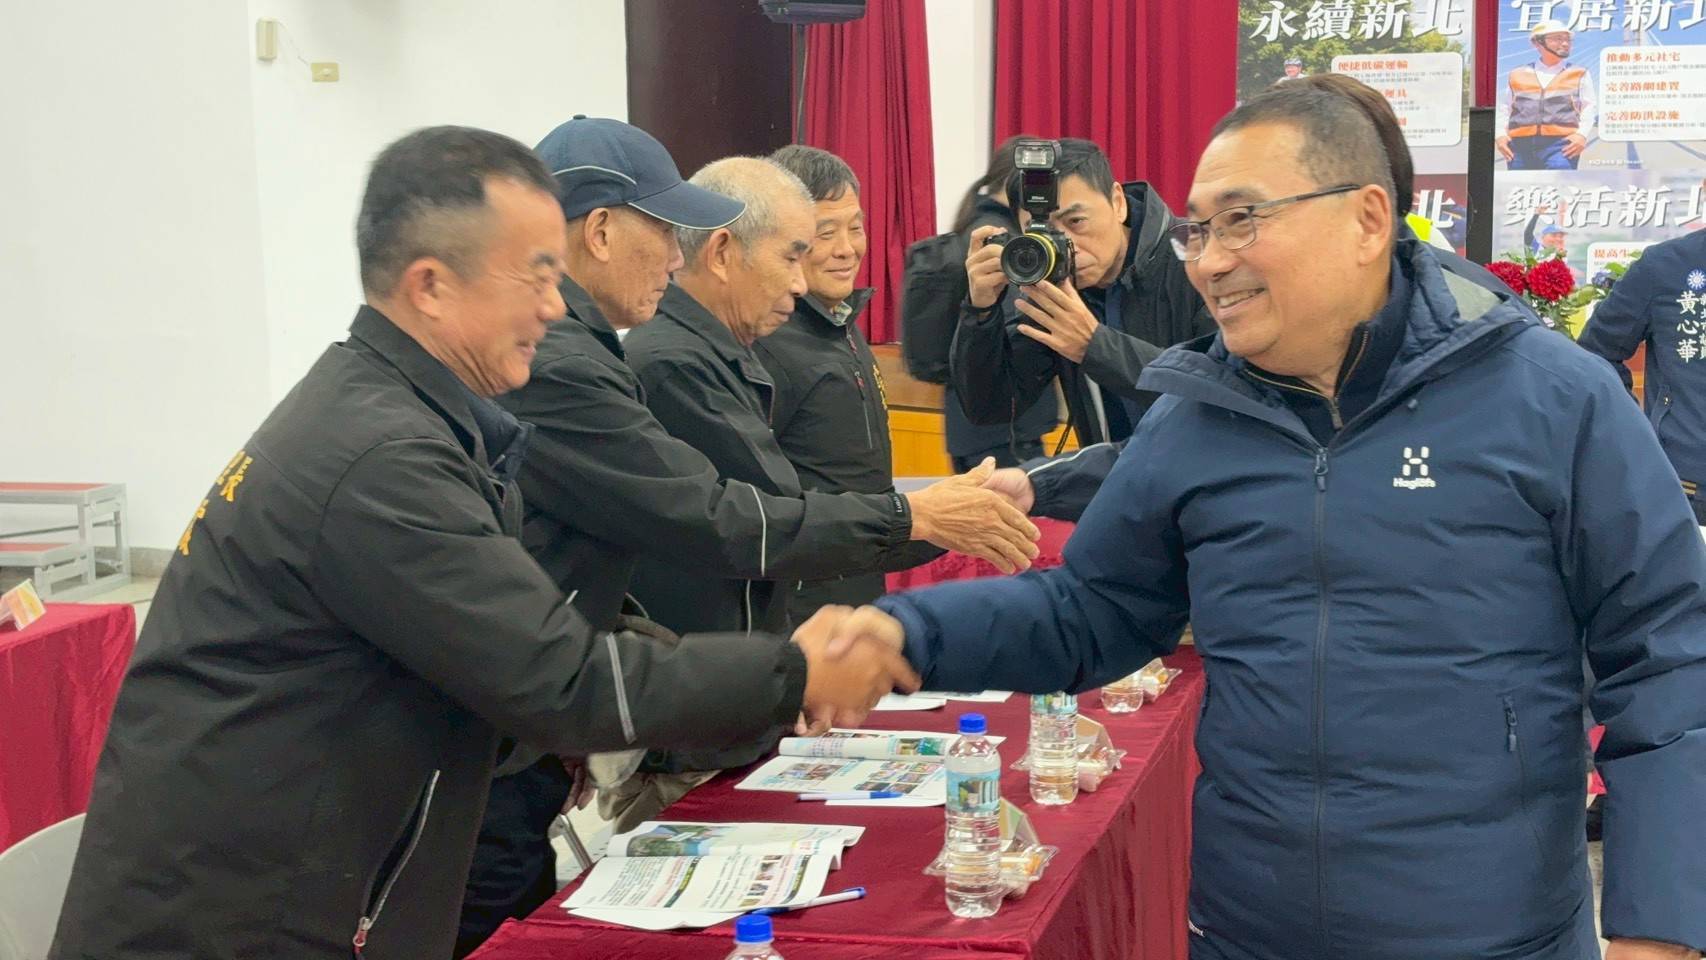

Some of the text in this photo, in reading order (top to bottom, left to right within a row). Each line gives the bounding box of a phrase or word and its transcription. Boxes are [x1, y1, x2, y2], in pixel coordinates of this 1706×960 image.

[1250, 0, 1465, 41] 永續新北
[1676, 290, 1700, 363] 黃心華
